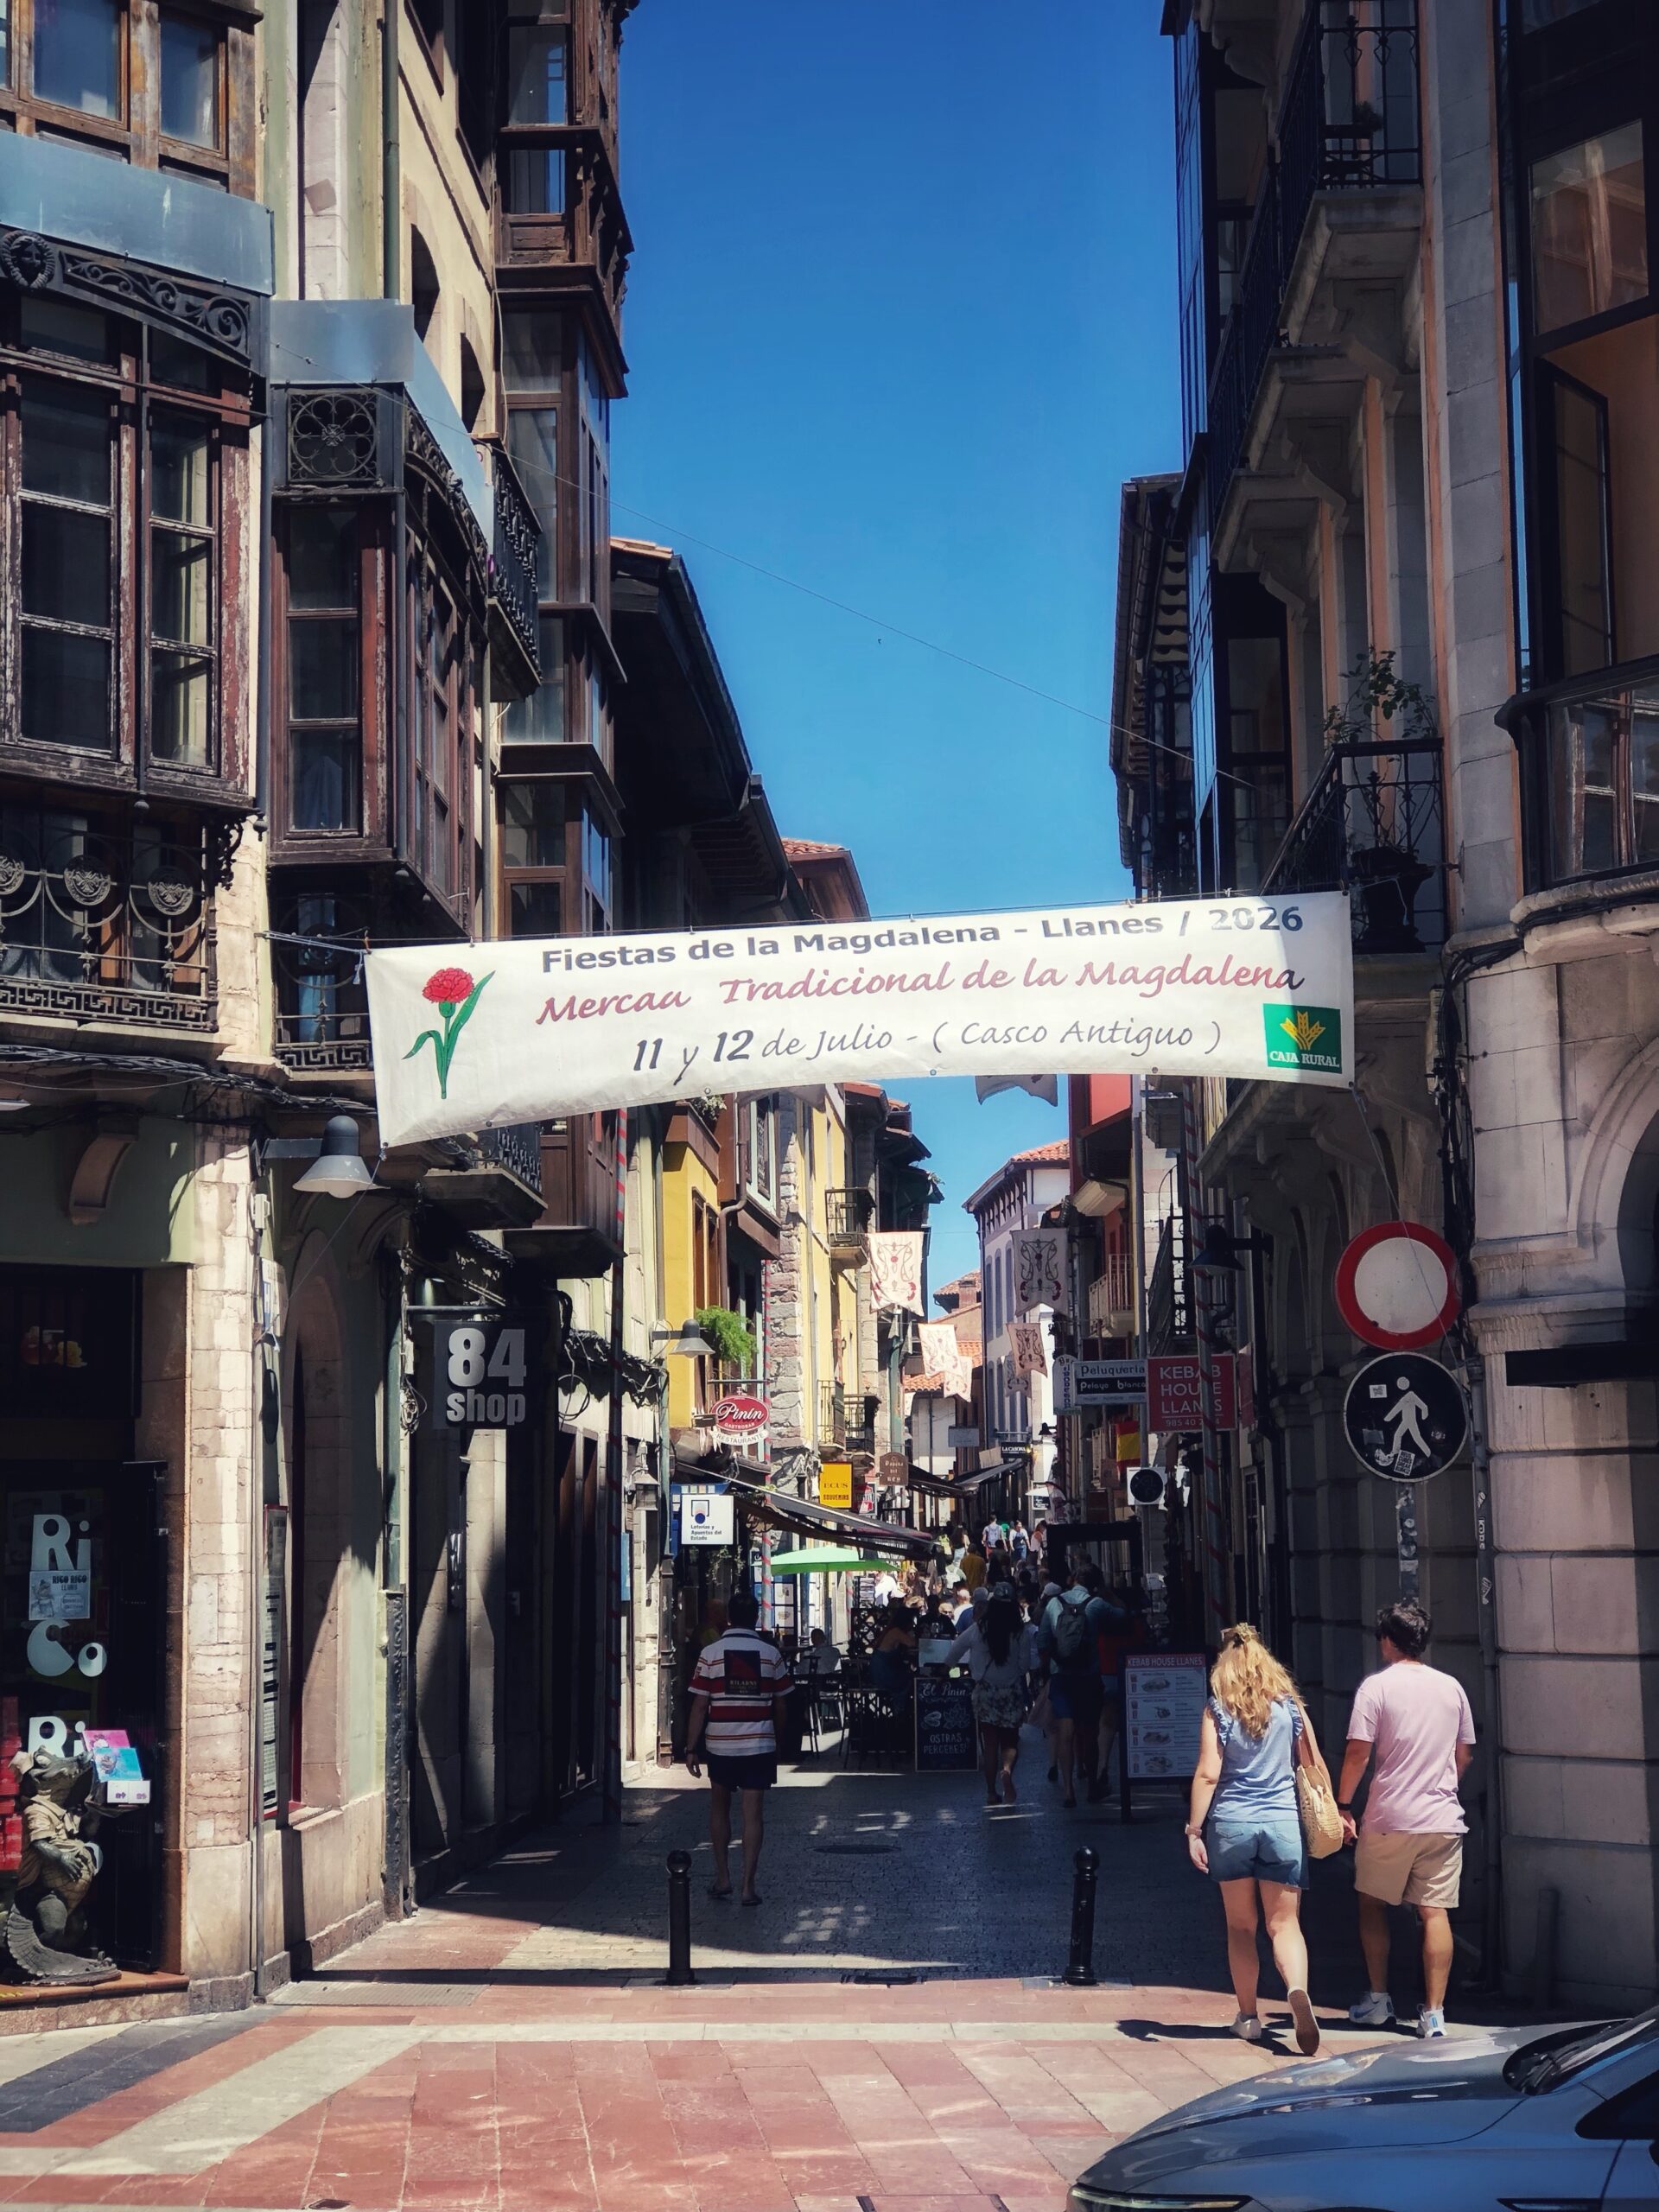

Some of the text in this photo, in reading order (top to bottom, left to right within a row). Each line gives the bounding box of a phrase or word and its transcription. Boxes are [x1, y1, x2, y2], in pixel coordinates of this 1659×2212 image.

[542, 945, 676, 973] Fiestas
[688, 939, 734, 960] de
[747, 937, 779, 956] la
[793, 927, 1001, 954] Magdalena
[1041, 916, 1164, 938] Llanes
[1179, 910, 1191, 937] /
[1209, 906, 1304, 931] 2026
[536, 953, 1306, 1025] Mercau Tradicional de la Magdalena
[632, 1038, 664, 1071] 11
[673, 1046, 699, 1086] y
[713, 1030, 754, 1062] 12
[761, 1027, 807, 1058] de
[804, 1023, 893, 1061] Julio
[961, 1022, 1048, 1045] Casco
[1059, 1018, 1193, 1058] Antiguo
[1269, 1051, 1340, 1068] CAJA RURAL
[448, 1327, 527, 1387] 84
[1160, 1382, 1222, 1397] HOUE
[446, 1389, 526, 1426] shop
[1161, 1399, 1223, 1414] LLANS
[1128, 1656, 1203, 1667] KEBAB HOUSE LLANES
[930, 1732, 963, 1744] OSTRAS
